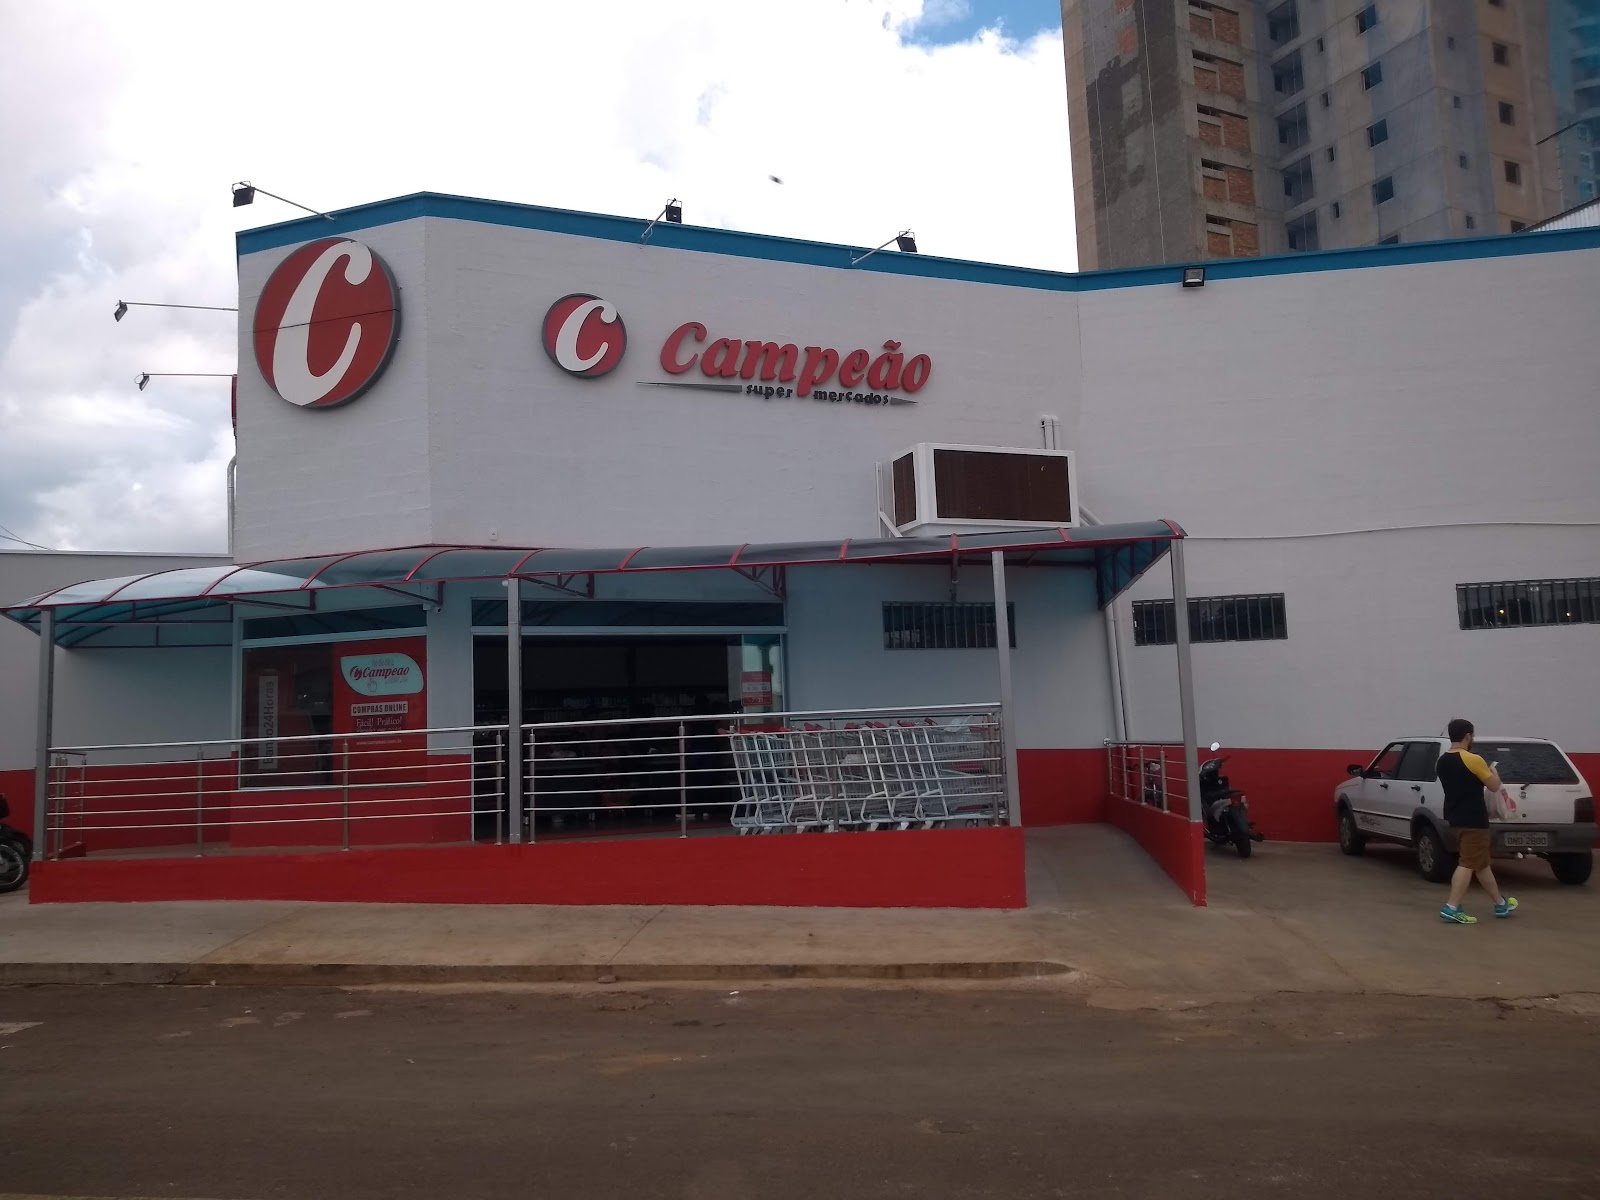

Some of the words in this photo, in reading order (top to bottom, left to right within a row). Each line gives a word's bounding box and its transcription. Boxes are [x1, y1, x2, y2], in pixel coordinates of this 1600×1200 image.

[660, 321, 932, 398] Campeão
[746, 383, 794, 400] super
[813, 389, 889, 405] mercados
[263, 681, 274, 764] Bano24Horas
[352, 704, 383, 714] COMPRAS
[384, 703, 407, 712] ONLINE
